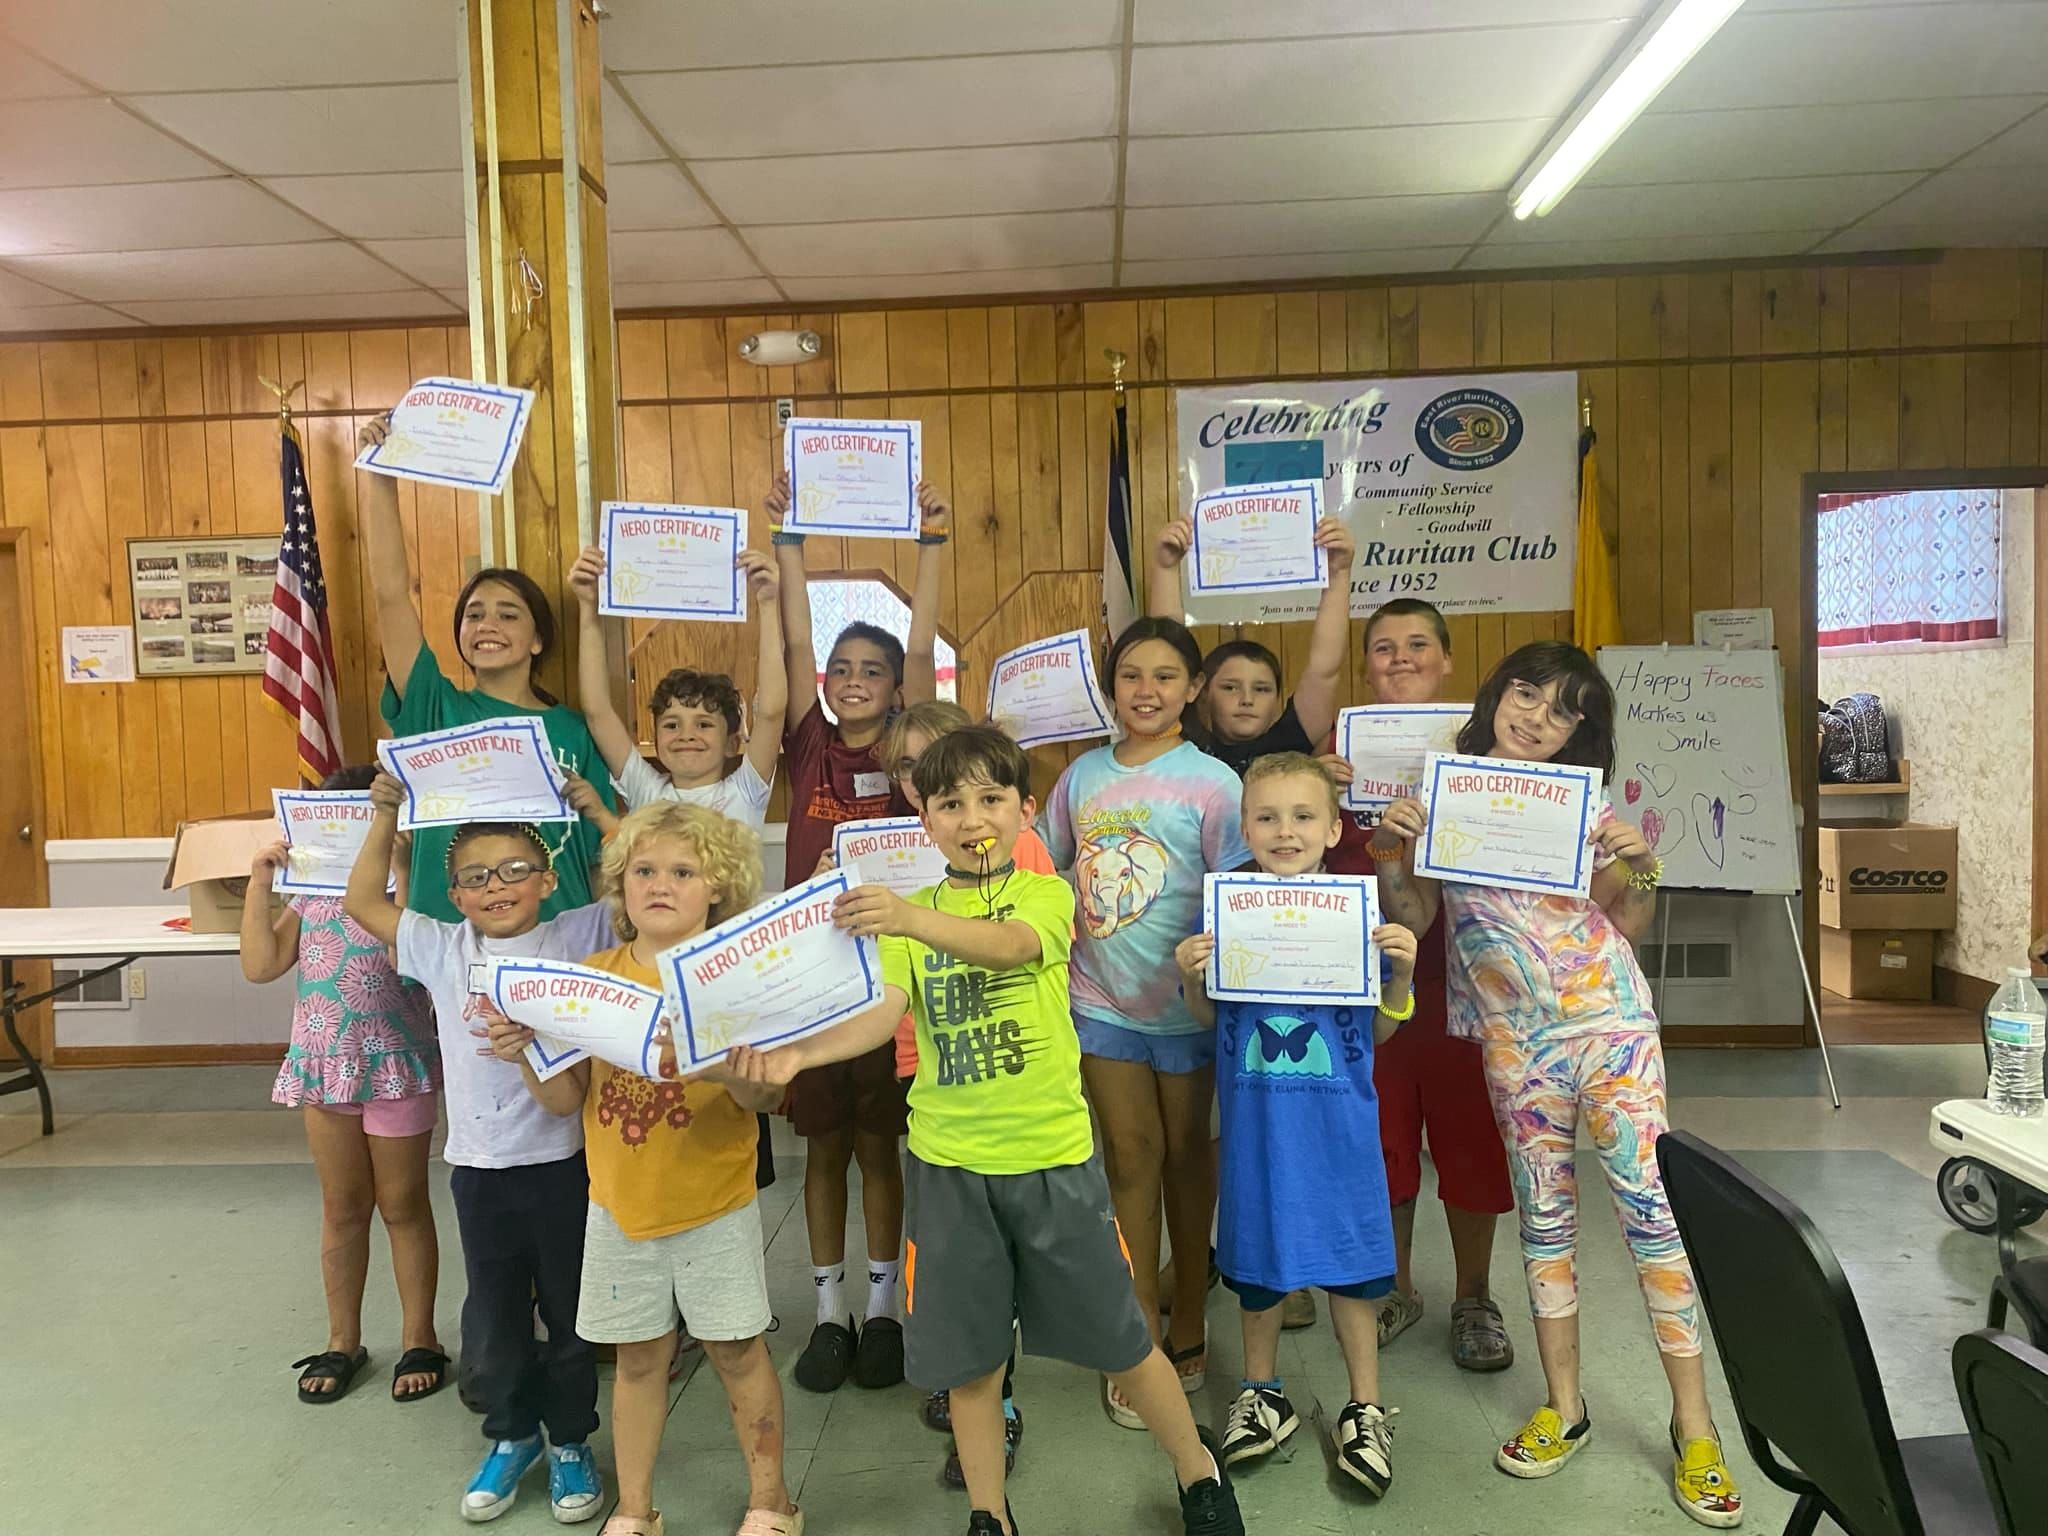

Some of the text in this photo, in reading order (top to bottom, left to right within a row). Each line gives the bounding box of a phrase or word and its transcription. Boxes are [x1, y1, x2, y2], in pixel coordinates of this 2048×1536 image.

[406, 391, 507, 419] HERO CERTIFICATE
[1437, 396, 1461, 409] River
[1463, 392, 1500, 405] Ruritan
[1501, 404, 1516, 425] Club
[1199, 399, 1391, 448] Celebrating
[802, 435, 896, 457] HERO CERTIFICATE
[1389, 453, 1414, 477] of
[1355, 482, 1493, 499] Community Service
[1204, 498, 1301, 523] HERO CERTIFICATE
[1398, 501, 1476, 517] Fellowship
[620, 519, 723, 542] HERO CERTIFICATE
[1428, 519, 1492, 534] Goodwill
[1363, 535, 1557, 567] Ruritan Club
[1388, 572, 1439, 593] 1952
[1442, 599, 1466, 609] place
[1000, 652, 1071, 686] HERO CERTIFICATE
[1615, 661, 1765, 702] Happy Faces
[1627, 702, 1717, 723] Makes us
[406, 735, 523, 770] HERO CERTIFICATE
[1657, 729, 1721, 752] Smile
[1448, 775, 1571, 806] HERO CERTIFICATE
[290, 805, 376, 823] HERO CERTIFICAT
[1077, 799, 1152, 825] Lincoln
[847, 837, 878, 859] HERO
[1228, 890, 1350, 913] HERO CERTIFICATE
[694, 900, 831, 986] HERO CERTIFICATE
[509, 978, 642, 1011] HERO CERTIFICATE
[924, 971, 993, 1028] FOR
[934, 1019, 1025, 1086] DAYS
